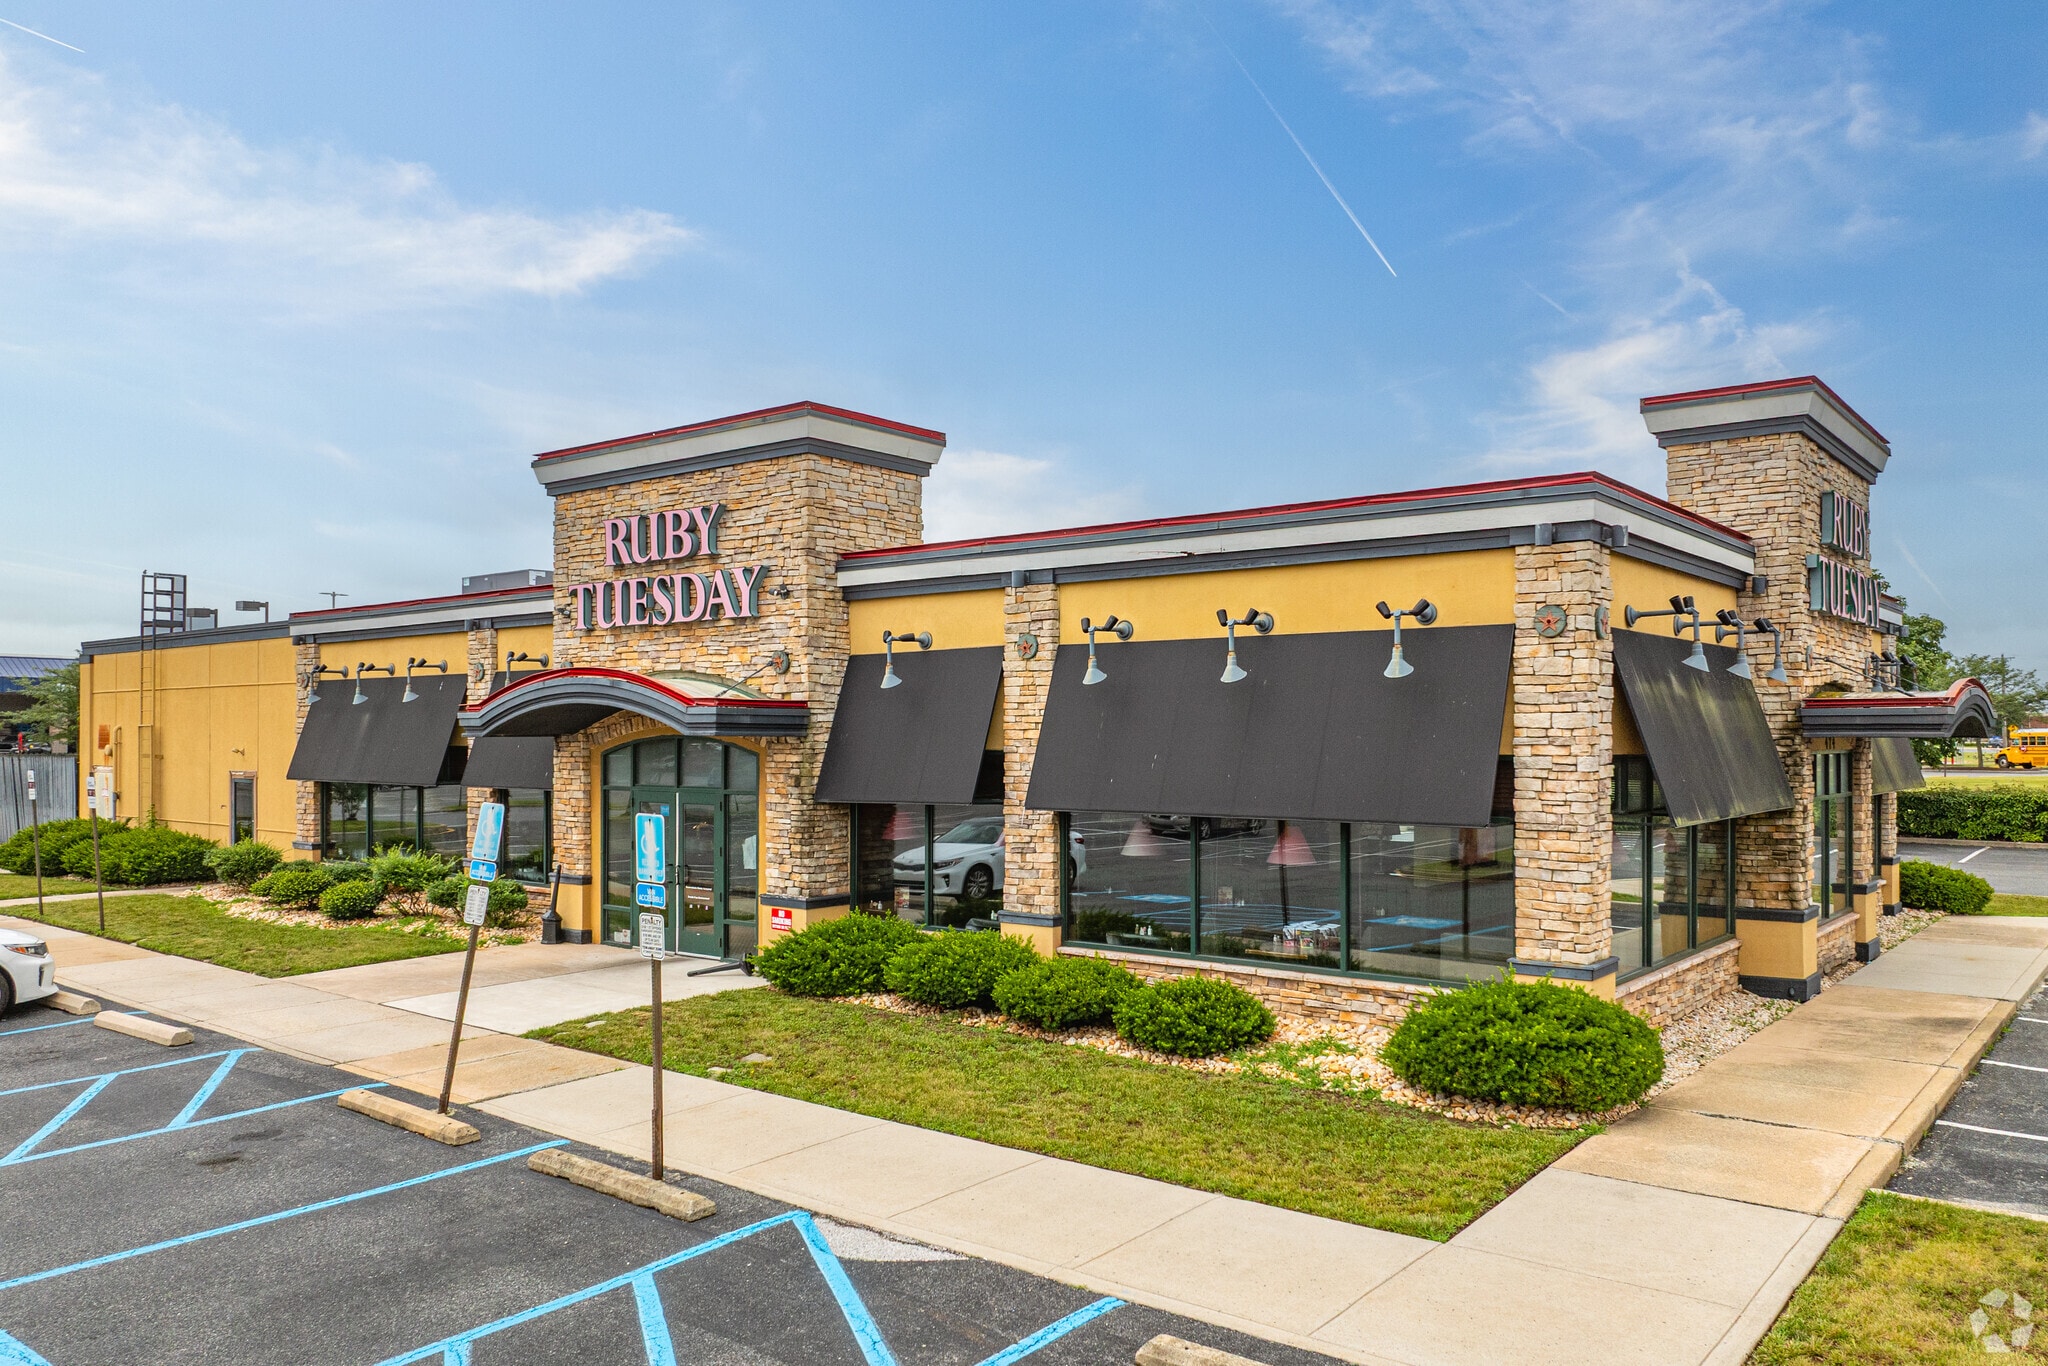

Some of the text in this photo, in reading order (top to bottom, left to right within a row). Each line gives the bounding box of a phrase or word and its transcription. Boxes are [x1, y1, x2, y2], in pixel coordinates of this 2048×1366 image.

[602, 503, 723, 567] RUBY
[1832, 491, 1871, 560] RUBY
[568, 565, 766, 631] TUESDAY
[1817, 554, 1882, 628] TUESDAY
